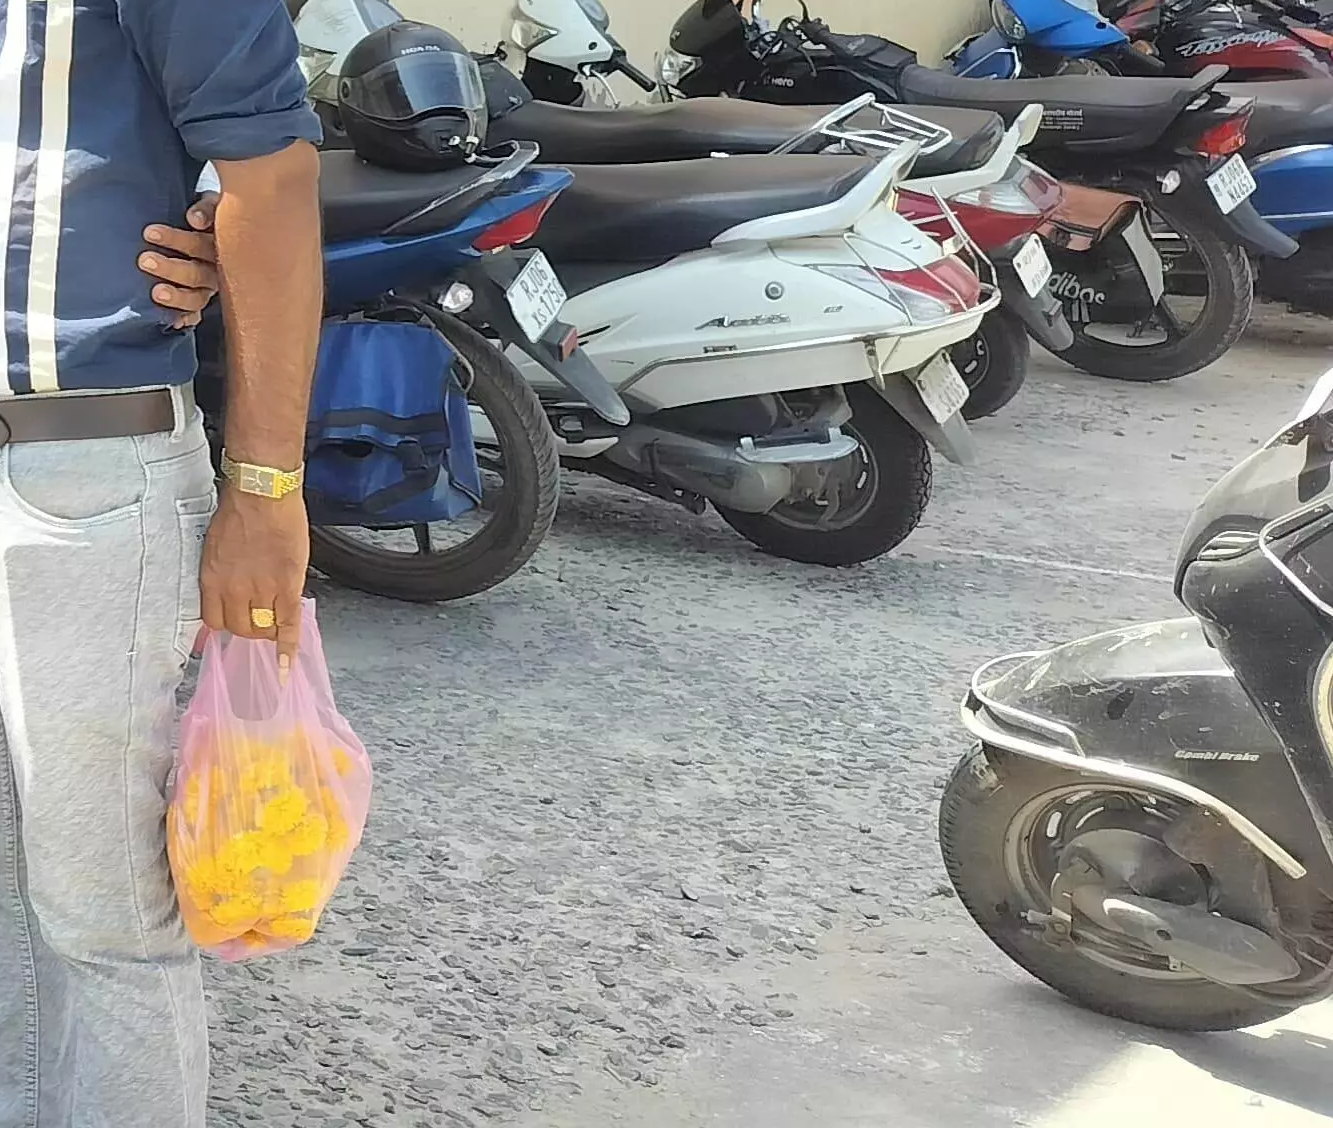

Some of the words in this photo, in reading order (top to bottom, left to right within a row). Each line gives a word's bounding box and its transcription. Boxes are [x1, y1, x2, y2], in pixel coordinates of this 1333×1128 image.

[520, 261, 549, 302] RJ06
[1175, 750, 1219, 761] Combi
[1218, 752, 1260, 762] Brake
